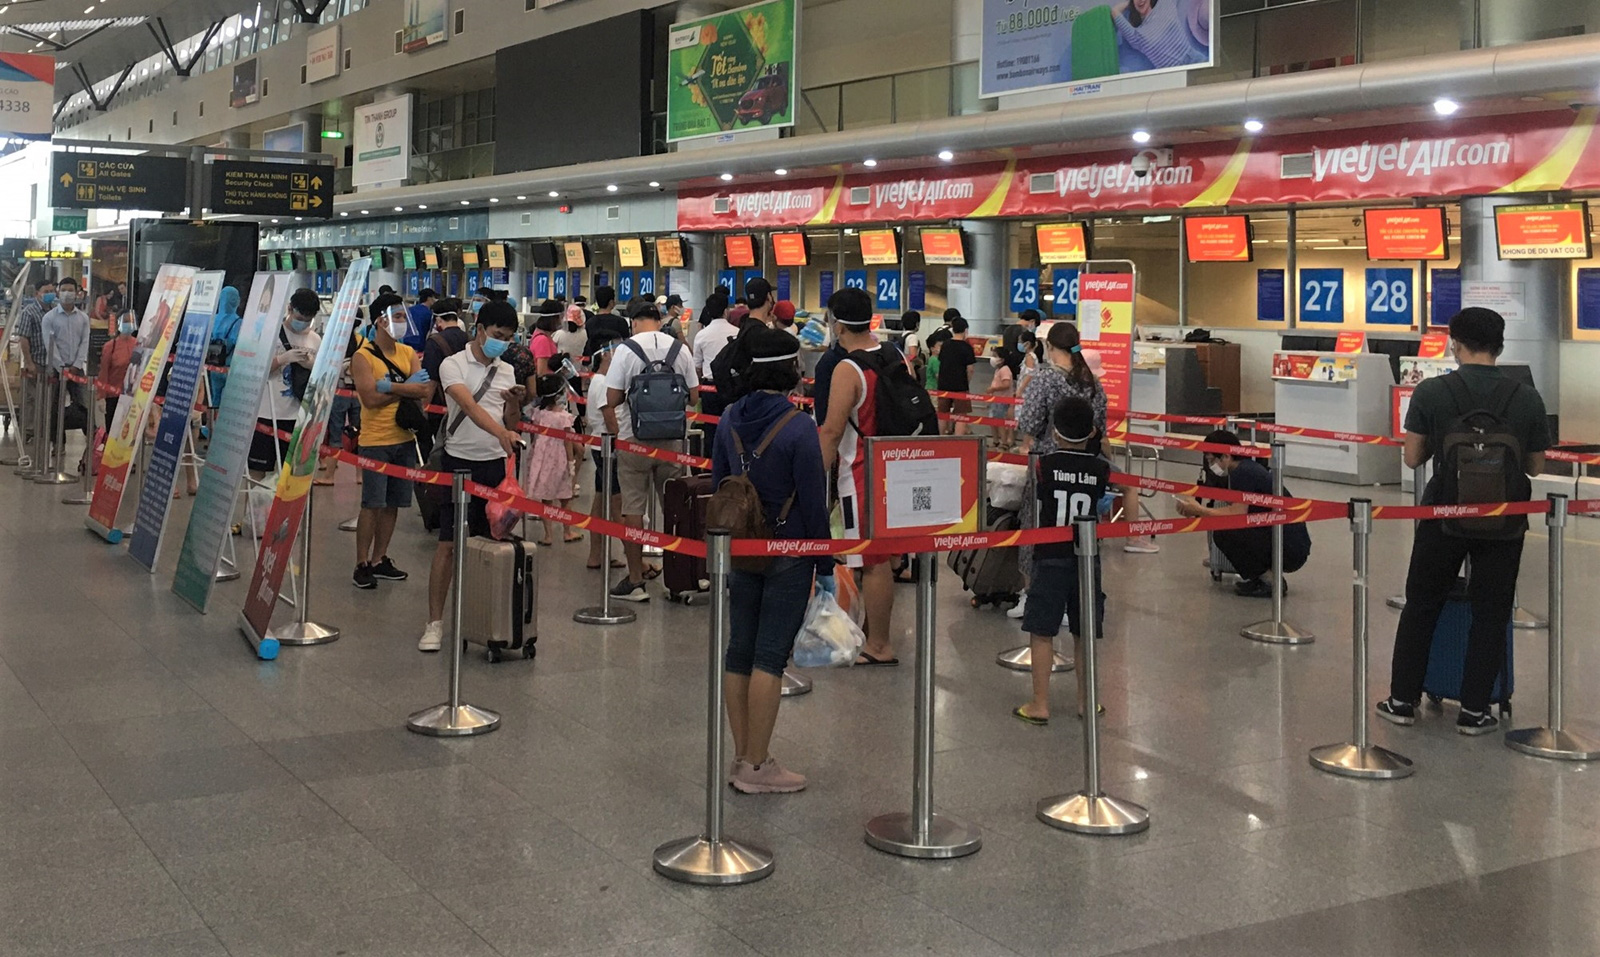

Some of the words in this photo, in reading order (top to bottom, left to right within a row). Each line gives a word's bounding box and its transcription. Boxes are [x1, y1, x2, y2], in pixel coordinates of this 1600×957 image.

[225, 179, 252, 188] Security
[98, 193, 121, 201] Toilets
[469, 276, 477, 291] 15
[538, 277, 548, 293] 17
[555, 277, 564, 293] 18
[620, 277, 631, 296] 19
[640, 277, 652, 296] 20
[879, 278, 898, 301] 24
[1013, 278, 1036, 304] 25
[1056, 278, 1078, 304] 26
[1305, 280, 1339, 311] 27
[1371, 280, 1408, 312] 28
[1053, 469, 1076, 485] Tùng
[1078, 471, 1097, 486] Lâm
[1053, 490, 1092, 529] 10
